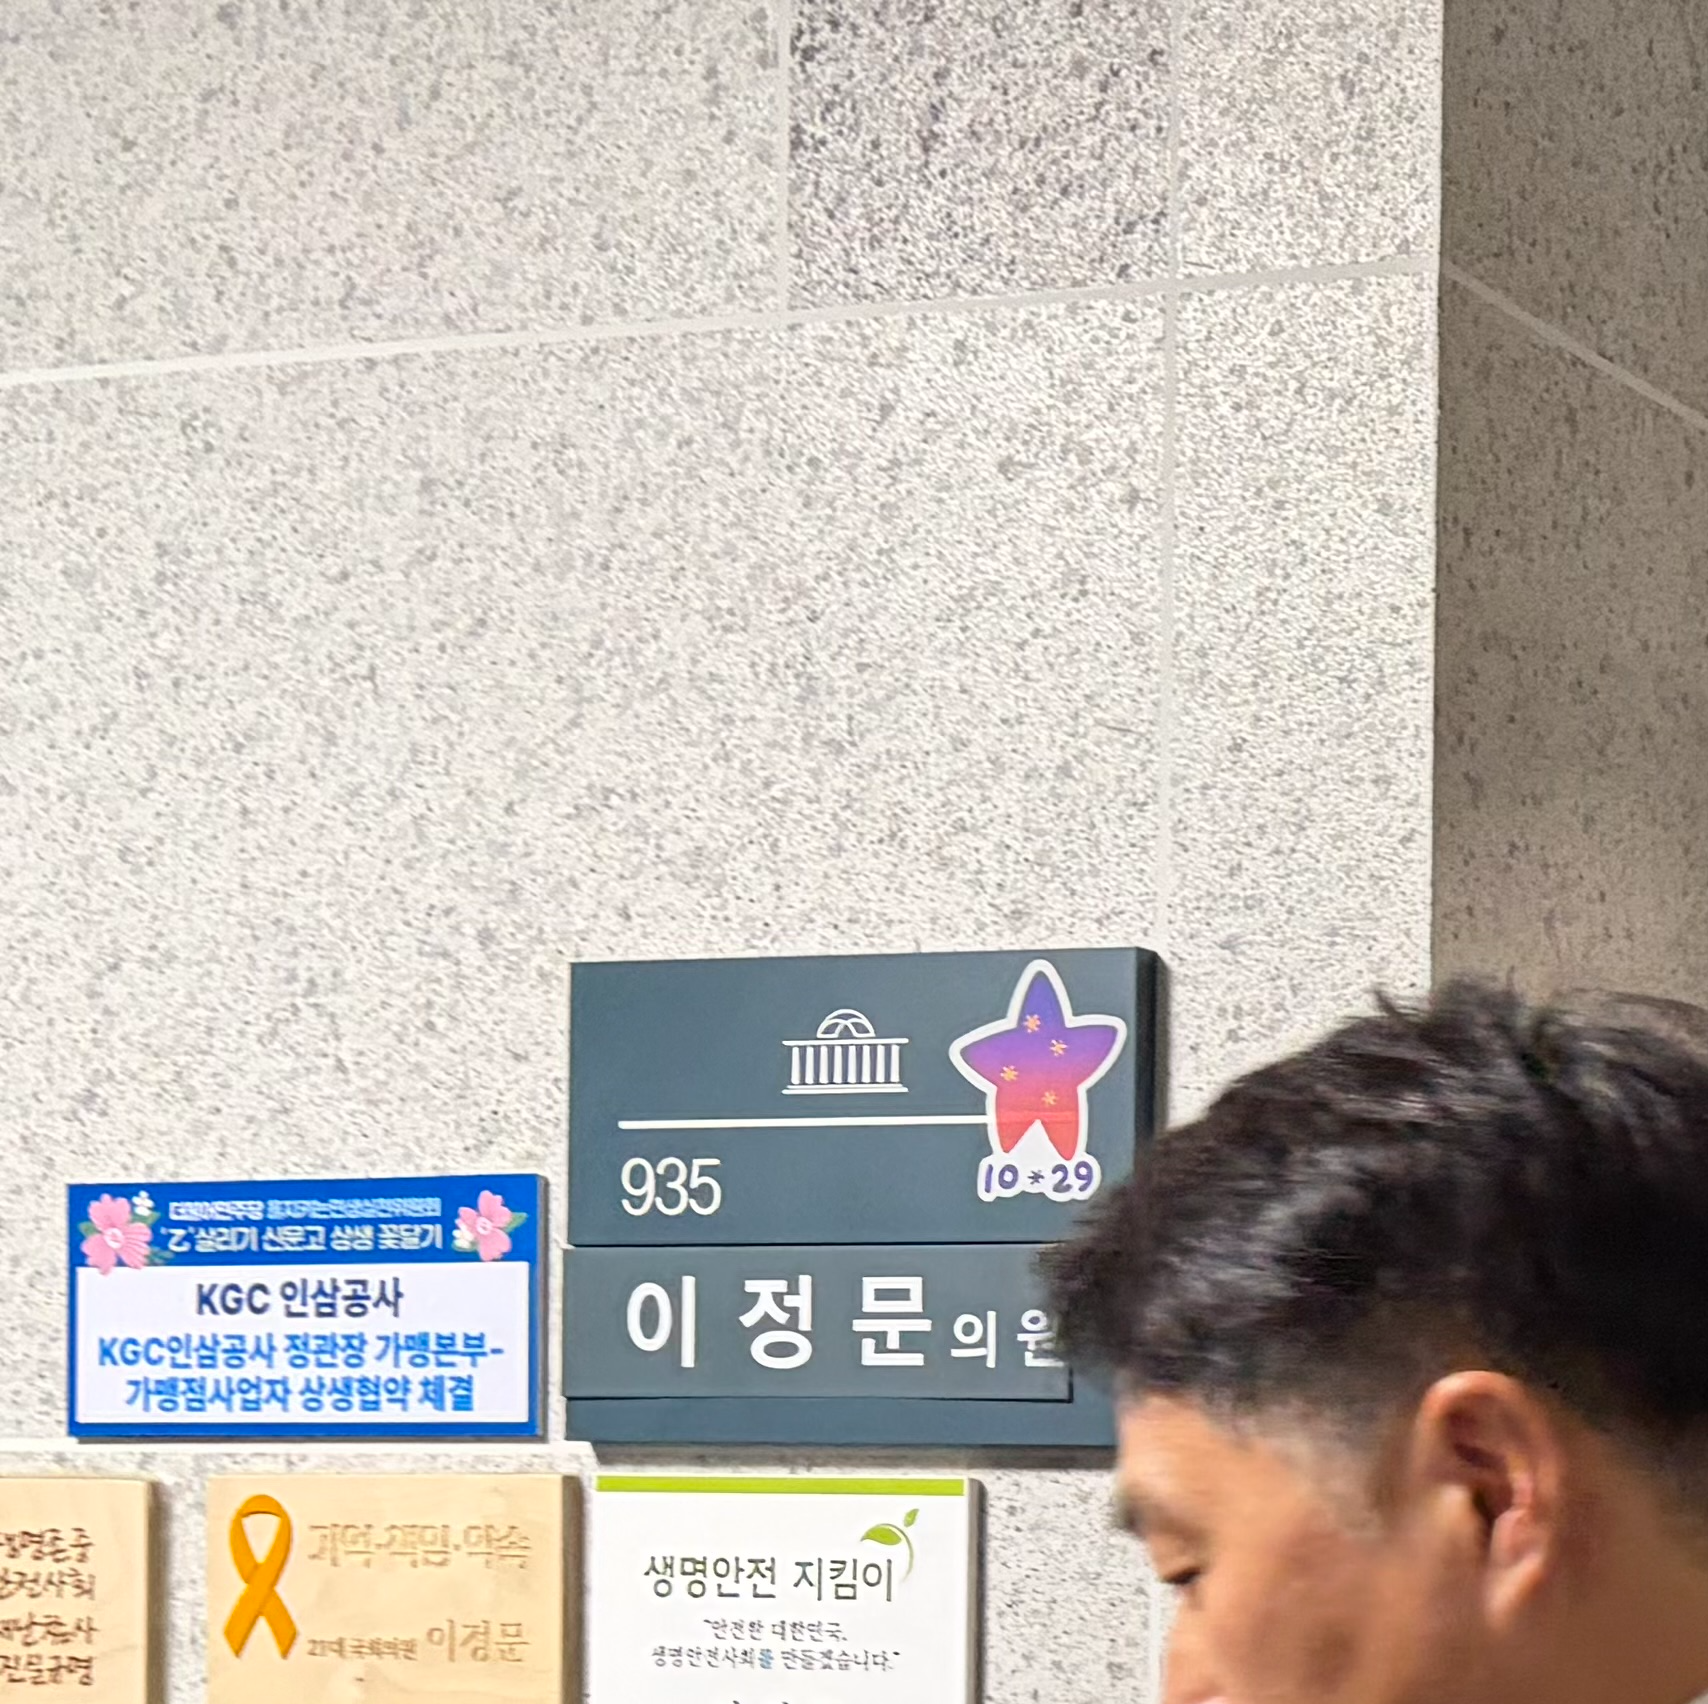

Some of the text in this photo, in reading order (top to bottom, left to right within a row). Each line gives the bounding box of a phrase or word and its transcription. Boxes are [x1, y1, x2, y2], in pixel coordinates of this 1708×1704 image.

[621, 1158, 721, 1215] 935
[262, 1225, 326, 1251] 신문고
[330, 1224, 375, 1251] 상생
[377, 1223, 443, 1249] 꽃달기
[195, 1277, 404, 1318] KGC 인삼공사
[98, 1332, 277, 1369] KGC인삼공사
[283, 1332, 367, 1369] 정관장
[126, 1374, 475, 1412] 가맹점사업자 상생협약 체결
[644, 1555, 893, 1602] 생명안전 지킴이
[426, 1619, 530, 1662] 이정문
[652, 1646, 774, 1671] 생명안전사회를
